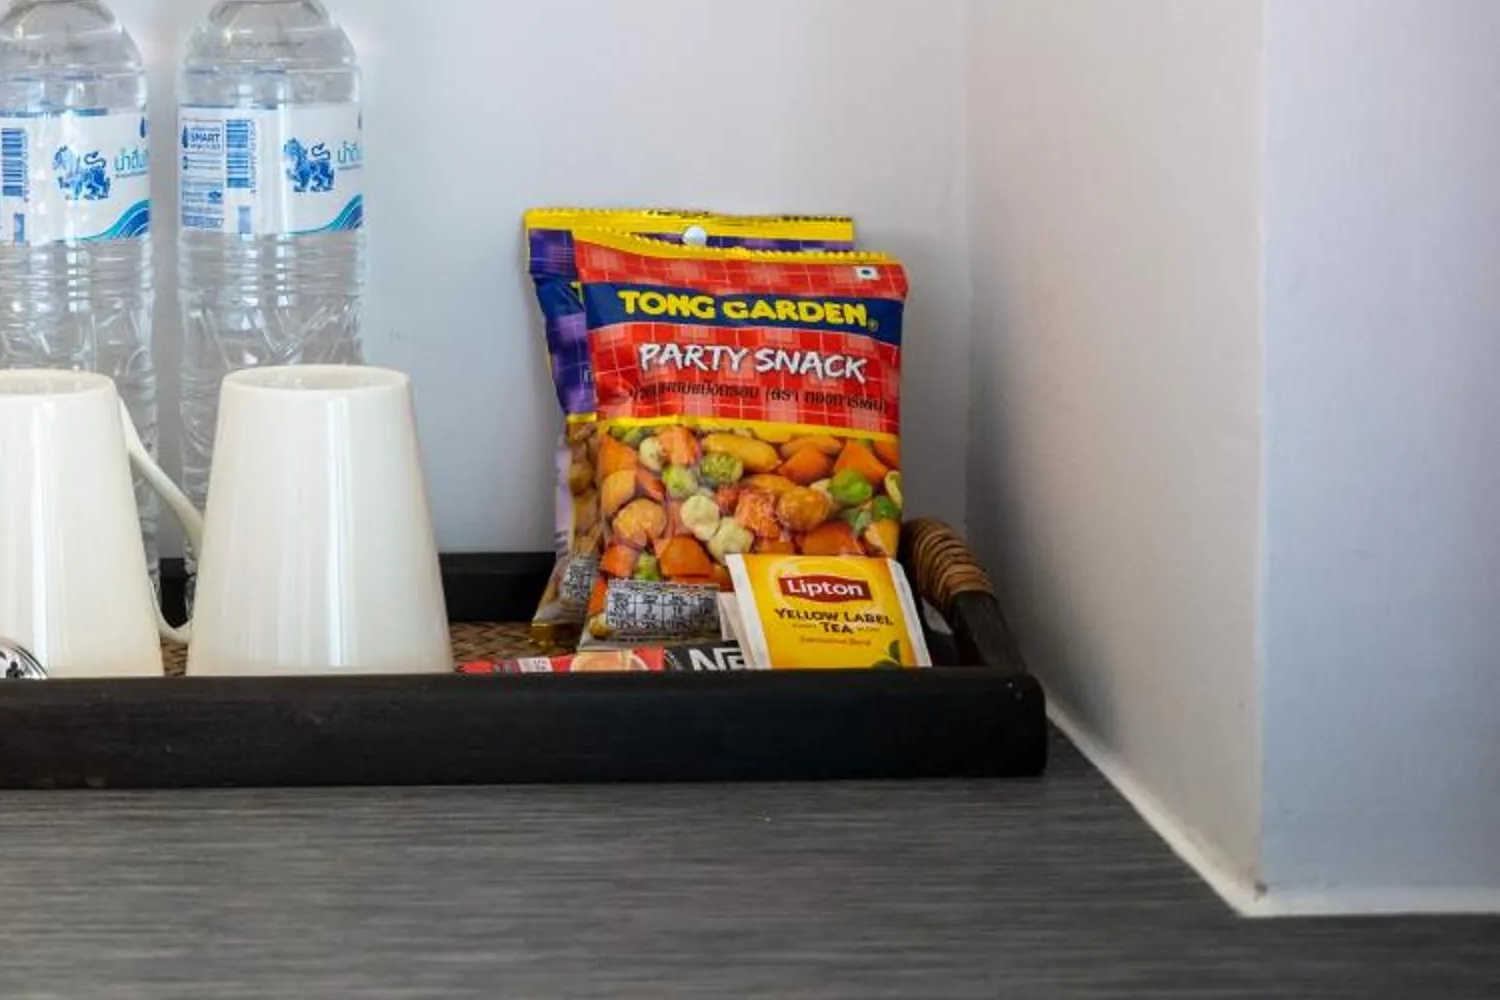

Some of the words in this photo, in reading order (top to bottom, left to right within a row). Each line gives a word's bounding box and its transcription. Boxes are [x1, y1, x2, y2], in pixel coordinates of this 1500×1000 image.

[617, 290, 716, 319] TONG
[722, 299, 868, 327] GARDEN
[639, 343, 748, 371] PARTY
[754, 347, 868, 383] SNACK
[787, 579, 864, 597] Lipton
[774, 608, 839, 621] YELLOW
[843, 611, 894, 626] LABEL
[819, 621, 855, 634] TEA
